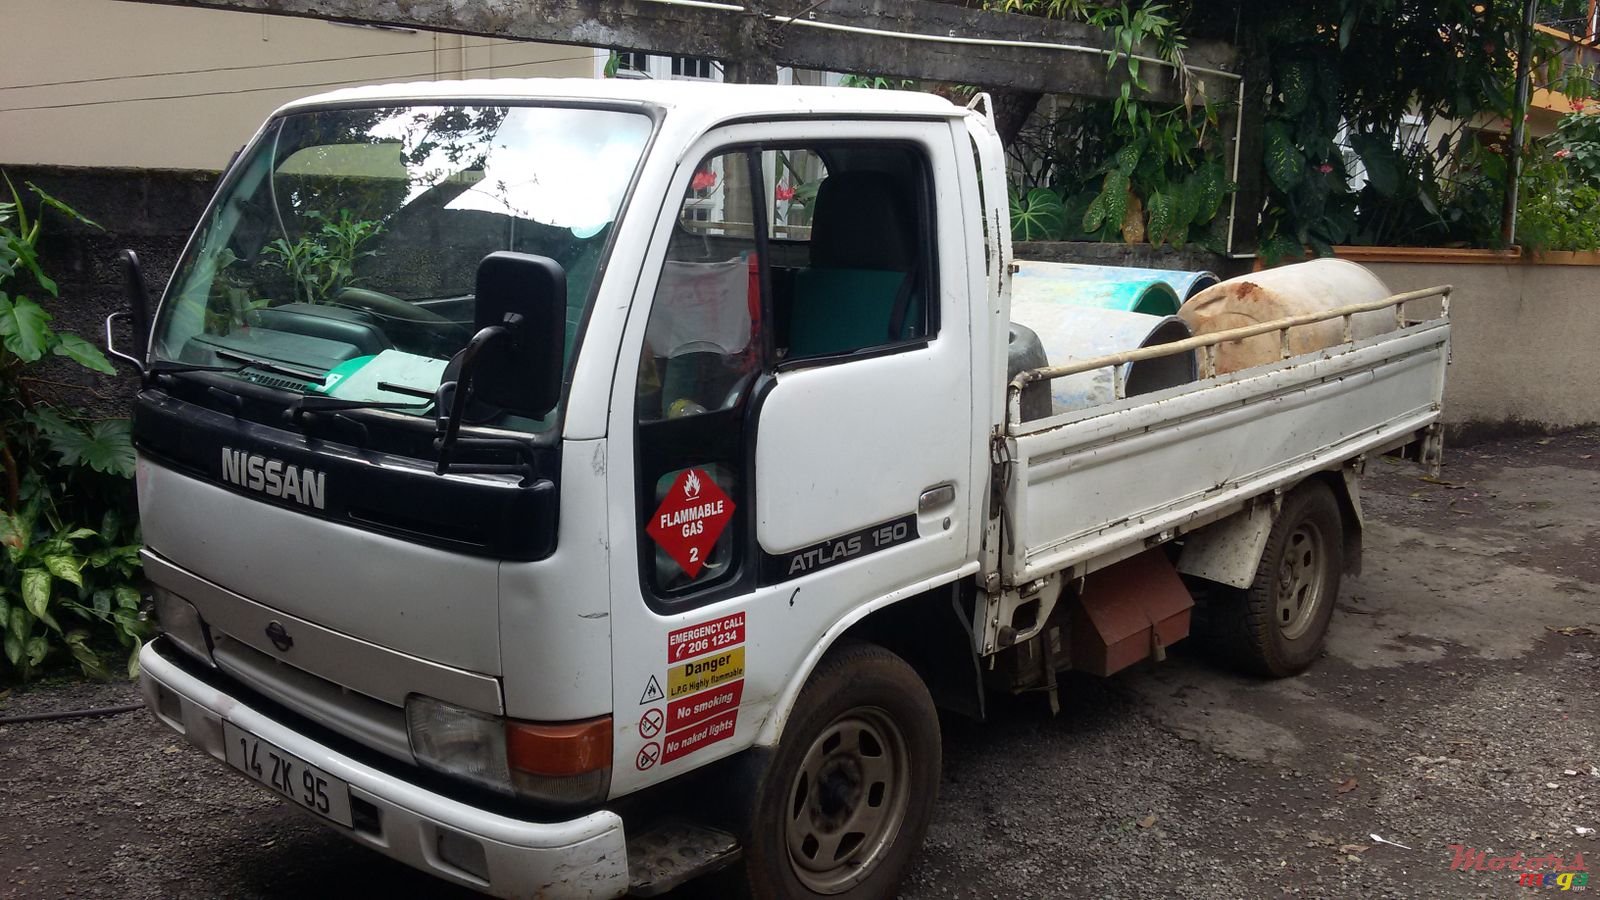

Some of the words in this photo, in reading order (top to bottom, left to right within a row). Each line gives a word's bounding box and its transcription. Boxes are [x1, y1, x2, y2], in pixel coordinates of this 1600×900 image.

[221, 447, 325, 509] NISSAN
[660, 500, 724, 528] FLAMMABLE
[682, 520, 703, 538] GAS
[689, 547, 699, 563] 2
[788, 535, 862, 575] ATLAS
[872, 521, 907, 546] 150
[670, 622, 722, 646] EMERGENCY
[724, 616, 744, 631] CALL
[688, 639, 709, 654] 206
[711, 630, 737, 646] 1234
[685, 654, 732, 677] Danger
[671, 683, 688, 696] L.P.G
[689, 679, 710, 691] Highly
[711, 667, 743, 684] flammable
[677, 707, 691, 719] No
[693, 692, 733, 714] smoking
[666, 741, 680, 754] No
[681, 728, 708, 748] naked
[708, 720, 733, 736] lights
[240, 738, 263, 778] 14
[269, 752, 294, 796] ZK
[303, 768, 330, 814] 95
